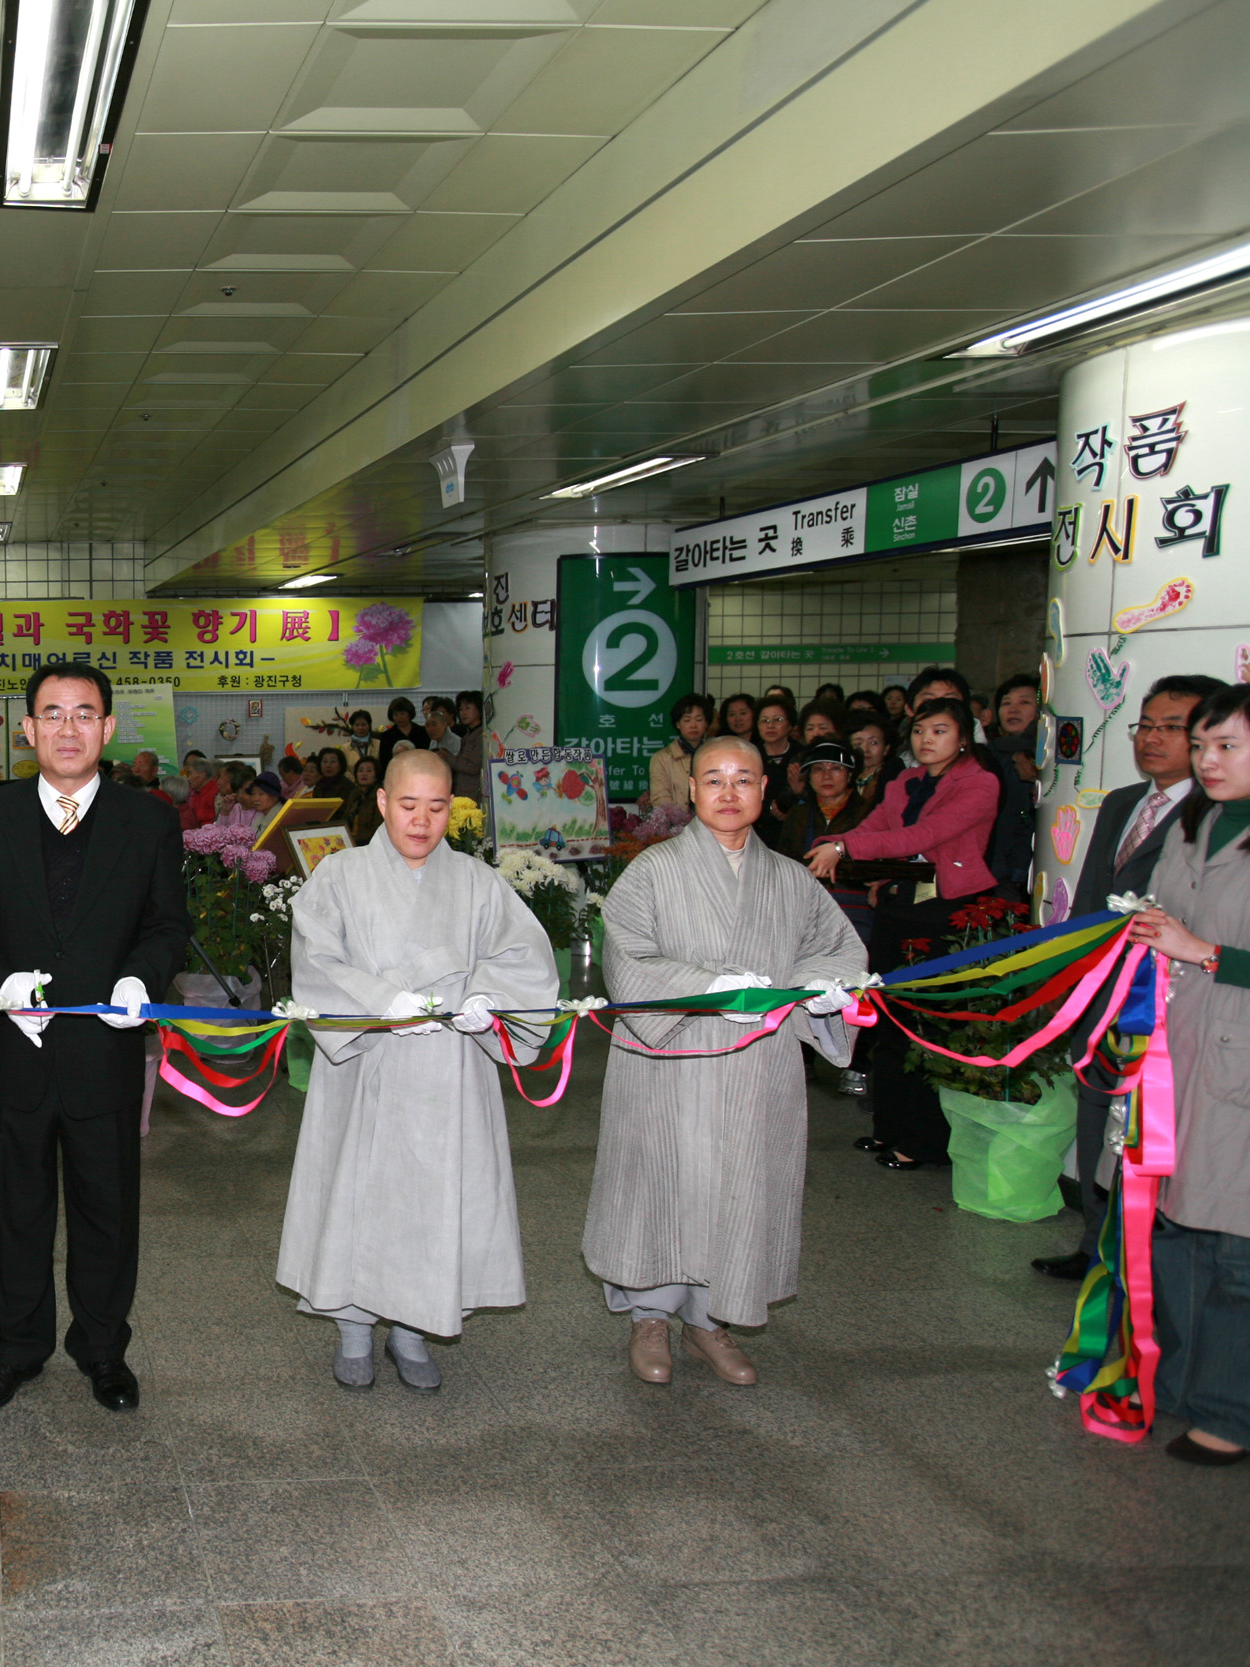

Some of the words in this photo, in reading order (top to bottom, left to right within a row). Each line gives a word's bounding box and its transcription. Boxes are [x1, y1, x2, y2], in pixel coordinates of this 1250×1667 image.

[1071, 401, 1188, 488] 작품
[893, 483, 919, 502] 잠실
[974, 476, 995, 514] 2
[896, 501, 915, 512] Jamsil
[892, 515, 918, 532] 신촌
[1053, 484, 1230, 566] 전시회
[673, 535, 748, 573] 갈아타는
[757, 524, 779, 555] 곳
[792, 501, 856, 532] Transfer
[790, 537, 804, 557] 換
[66, 610, 171, 645] 국화꽃
[192, 609, 257, 644] 향기
[280, 610, 312, 641] 展
[129, 649, 174, 670] 작품
[604, 621, 659, 691] 2
[727, 650, 756, 660] 2호선
[760, 650, 801, 660] 갈아타는
[253, 674, 302, 688] 광진구청
